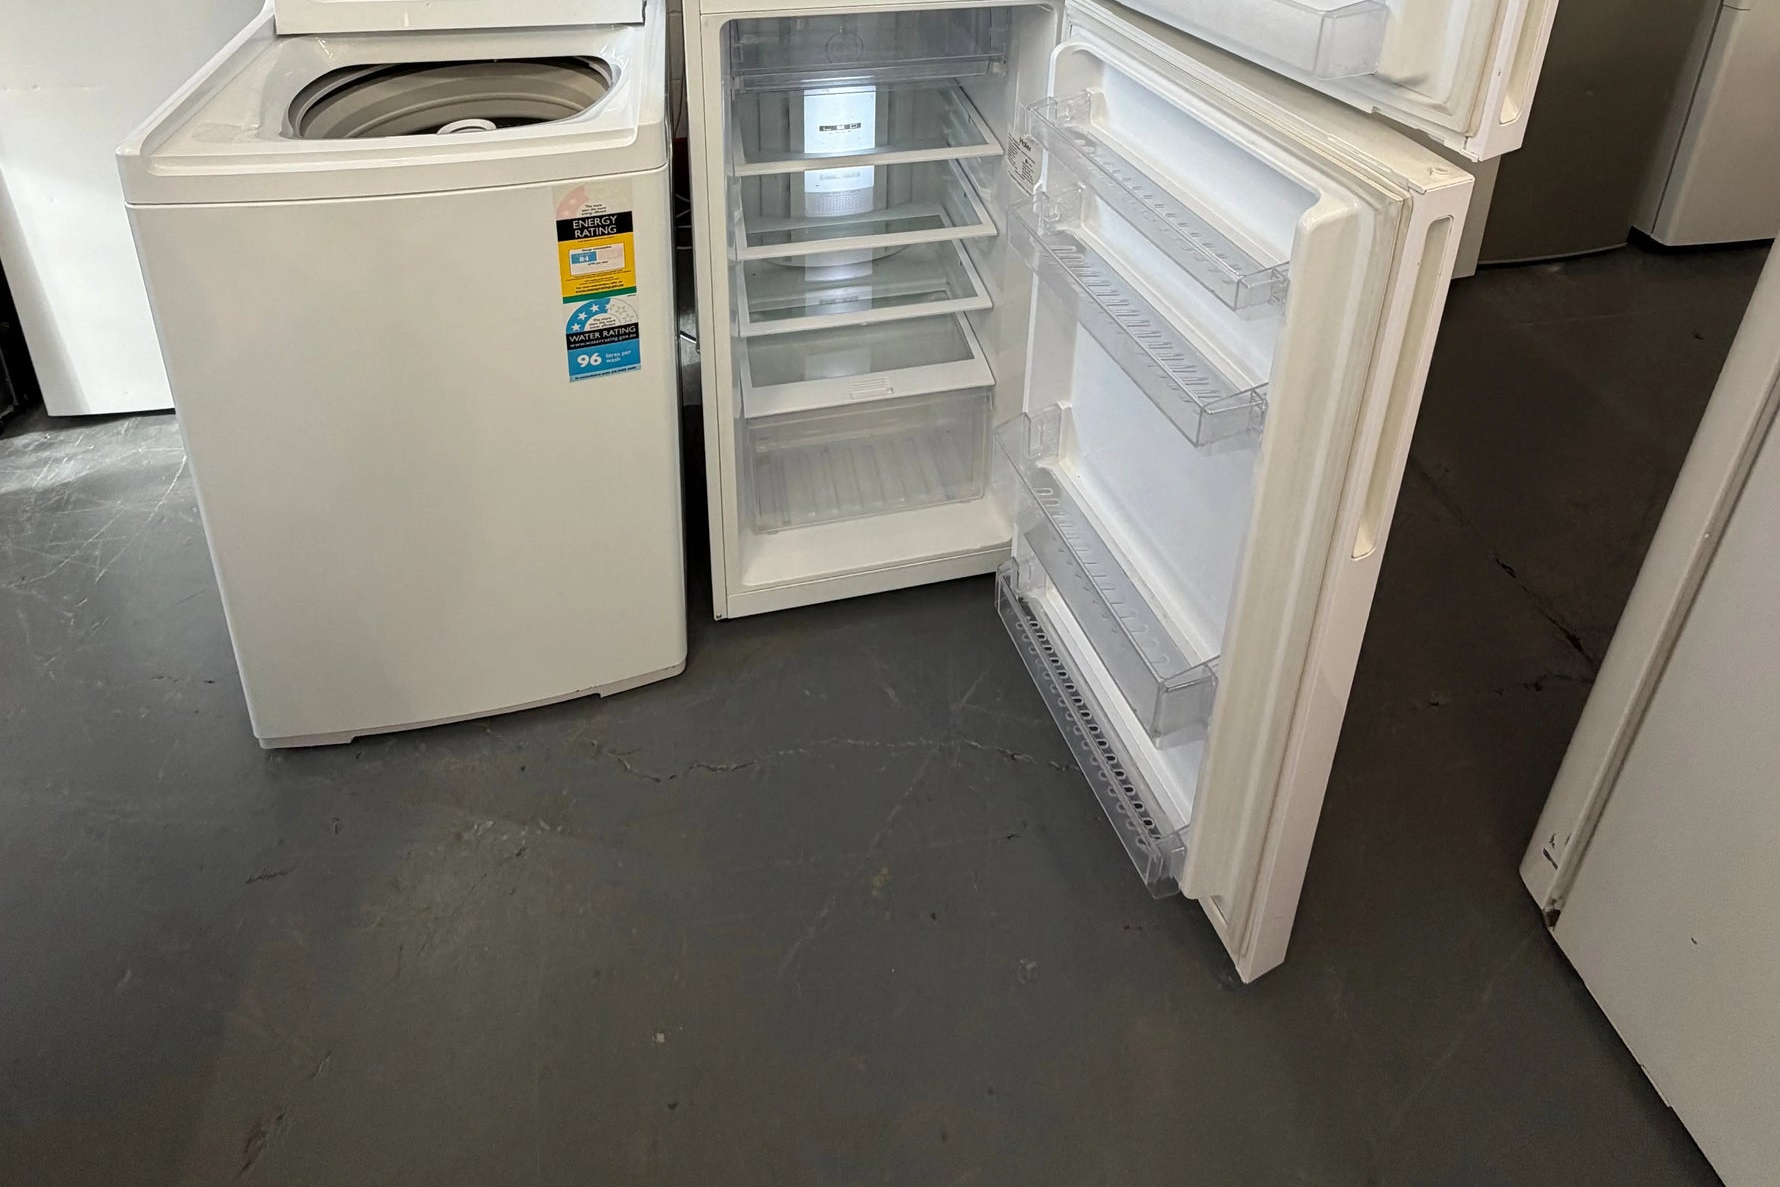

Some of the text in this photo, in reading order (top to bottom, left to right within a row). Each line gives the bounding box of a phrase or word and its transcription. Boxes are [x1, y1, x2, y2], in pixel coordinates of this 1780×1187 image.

[572, 214, 618, 229] ENERGY
[574, 225, 617, 239] RATING
[568, 325, 637, 343] WATER RATING
[577, 352, 602, 368] 96
